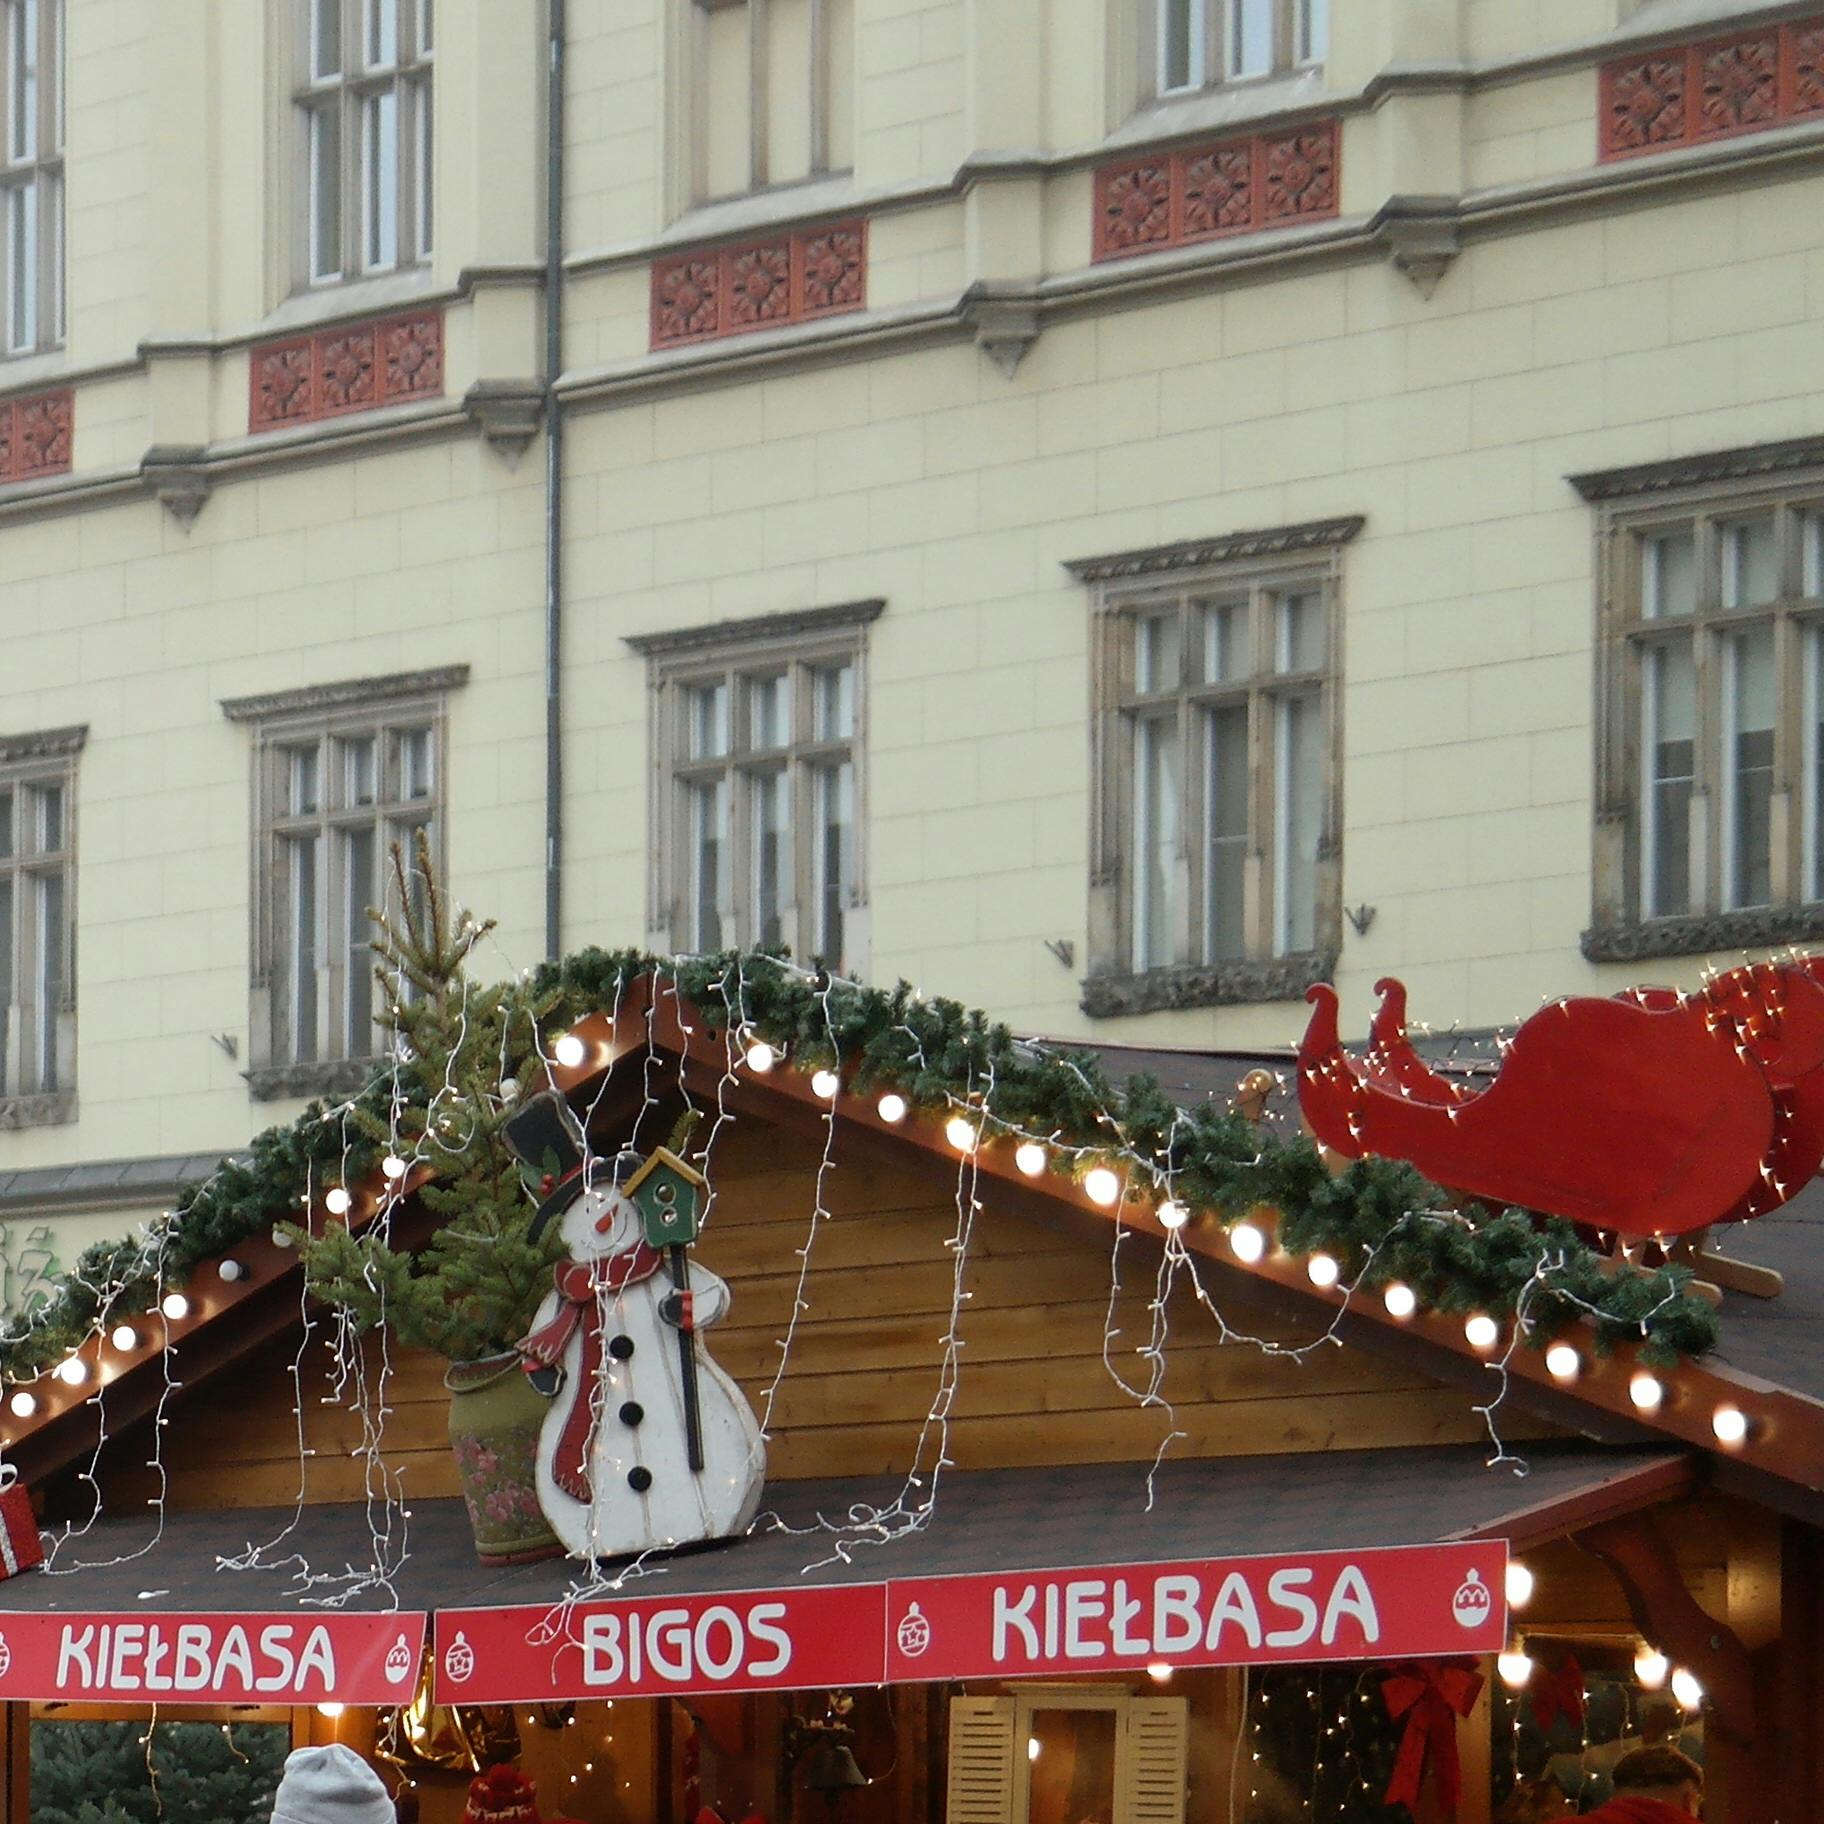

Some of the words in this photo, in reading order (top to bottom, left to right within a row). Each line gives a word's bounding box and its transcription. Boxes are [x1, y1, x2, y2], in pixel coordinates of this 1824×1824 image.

[584, 1603, 792, 1685] BIGOS
[992, 1565, 1379, 1662] KIEŁBASA
[56, 1624, 335, 1692] KIEŁBASA
